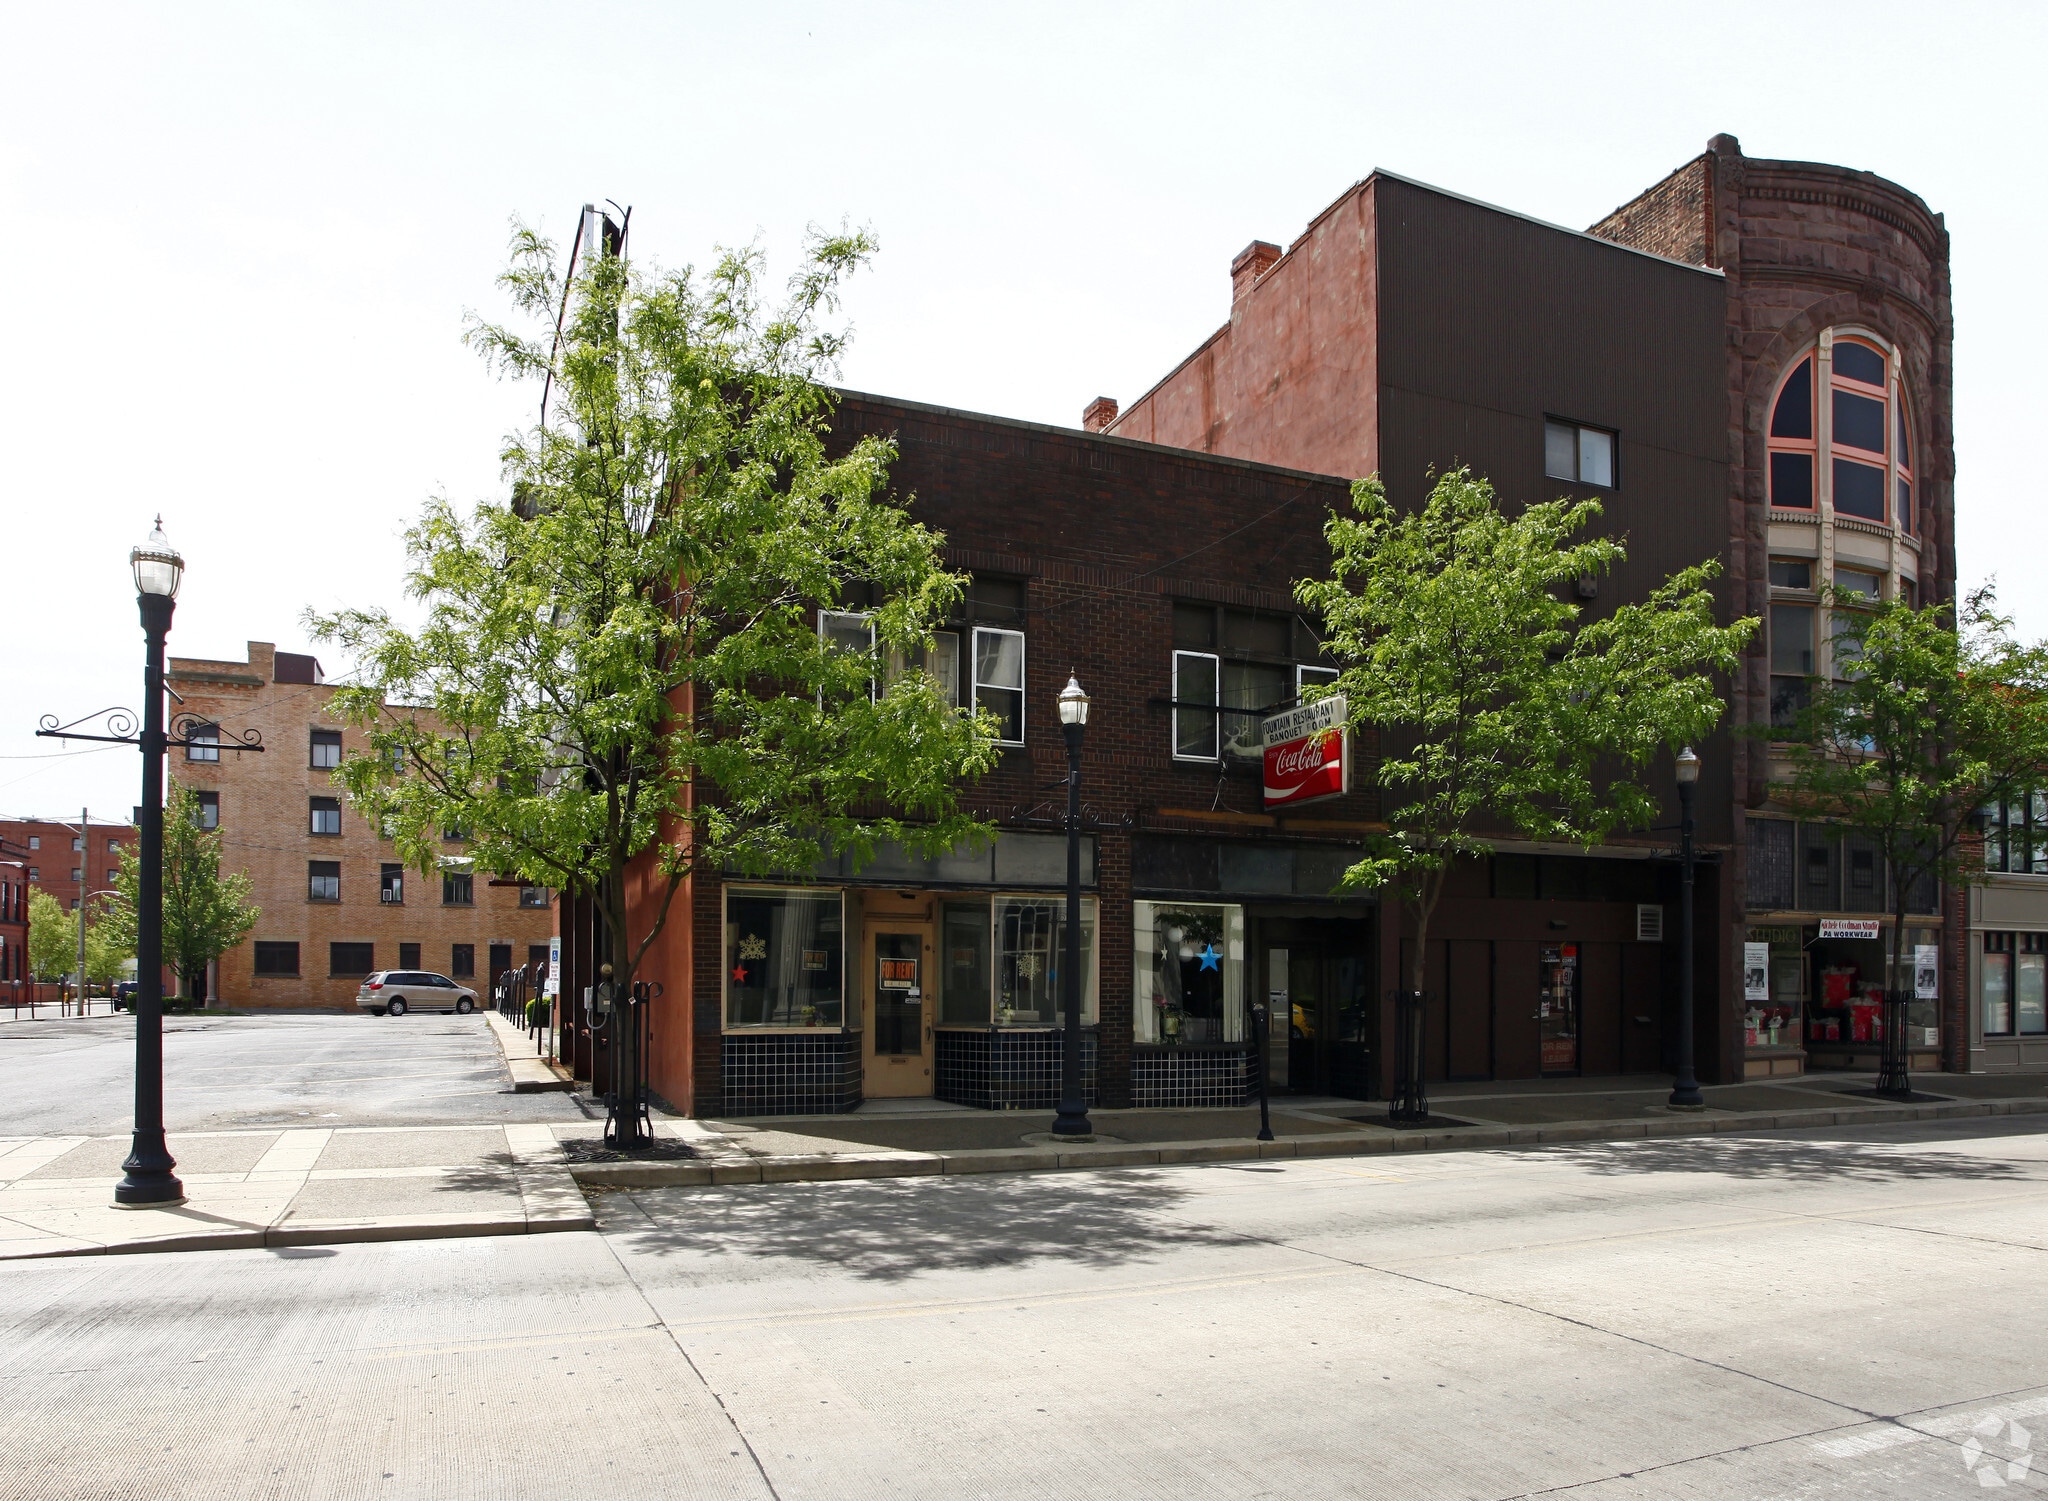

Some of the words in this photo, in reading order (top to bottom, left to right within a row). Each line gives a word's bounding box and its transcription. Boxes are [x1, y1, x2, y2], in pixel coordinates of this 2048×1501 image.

[1263, 715, 1291, 735] FOUNTAIN
[1293, 702, 1334, 726] RESTAURANT
[1269, 726, 1302, 744] BANQUET
[1276, 740, 1322, 776] Coca-Cola
[1745, 927, 1796, 943] STUDIO
[1833, 930, 1873, 938] WORKWEAR
[882, 961, 895, 978] FOR
[896, 961, 915, 979] RENT
